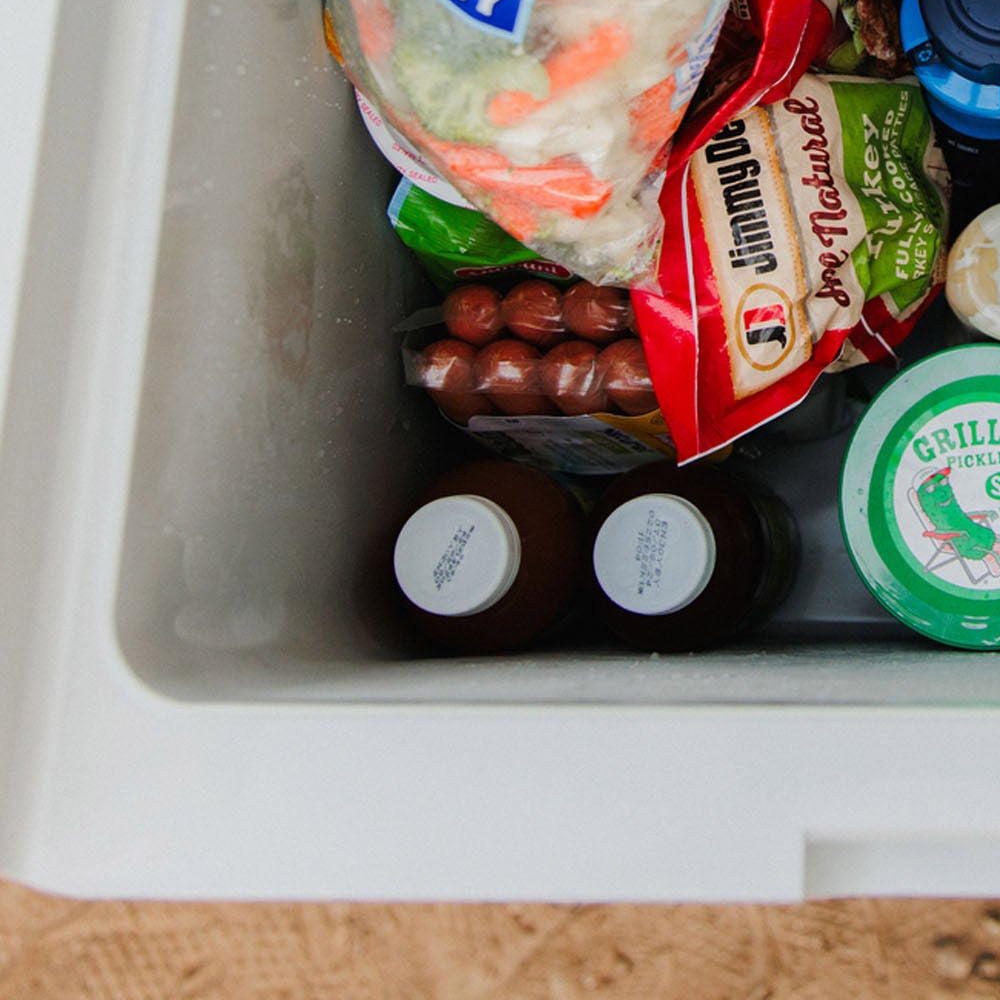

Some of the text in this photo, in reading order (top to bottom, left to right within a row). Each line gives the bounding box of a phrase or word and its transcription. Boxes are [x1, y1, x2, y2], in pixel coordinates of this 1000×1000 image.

[705, 118, 778, 275] Jimmy De
[784, 96, 849, 248] Natural
[881, 110, 924, 281] FULLY COOKED
[912, 237, 928, 281] RKEY
